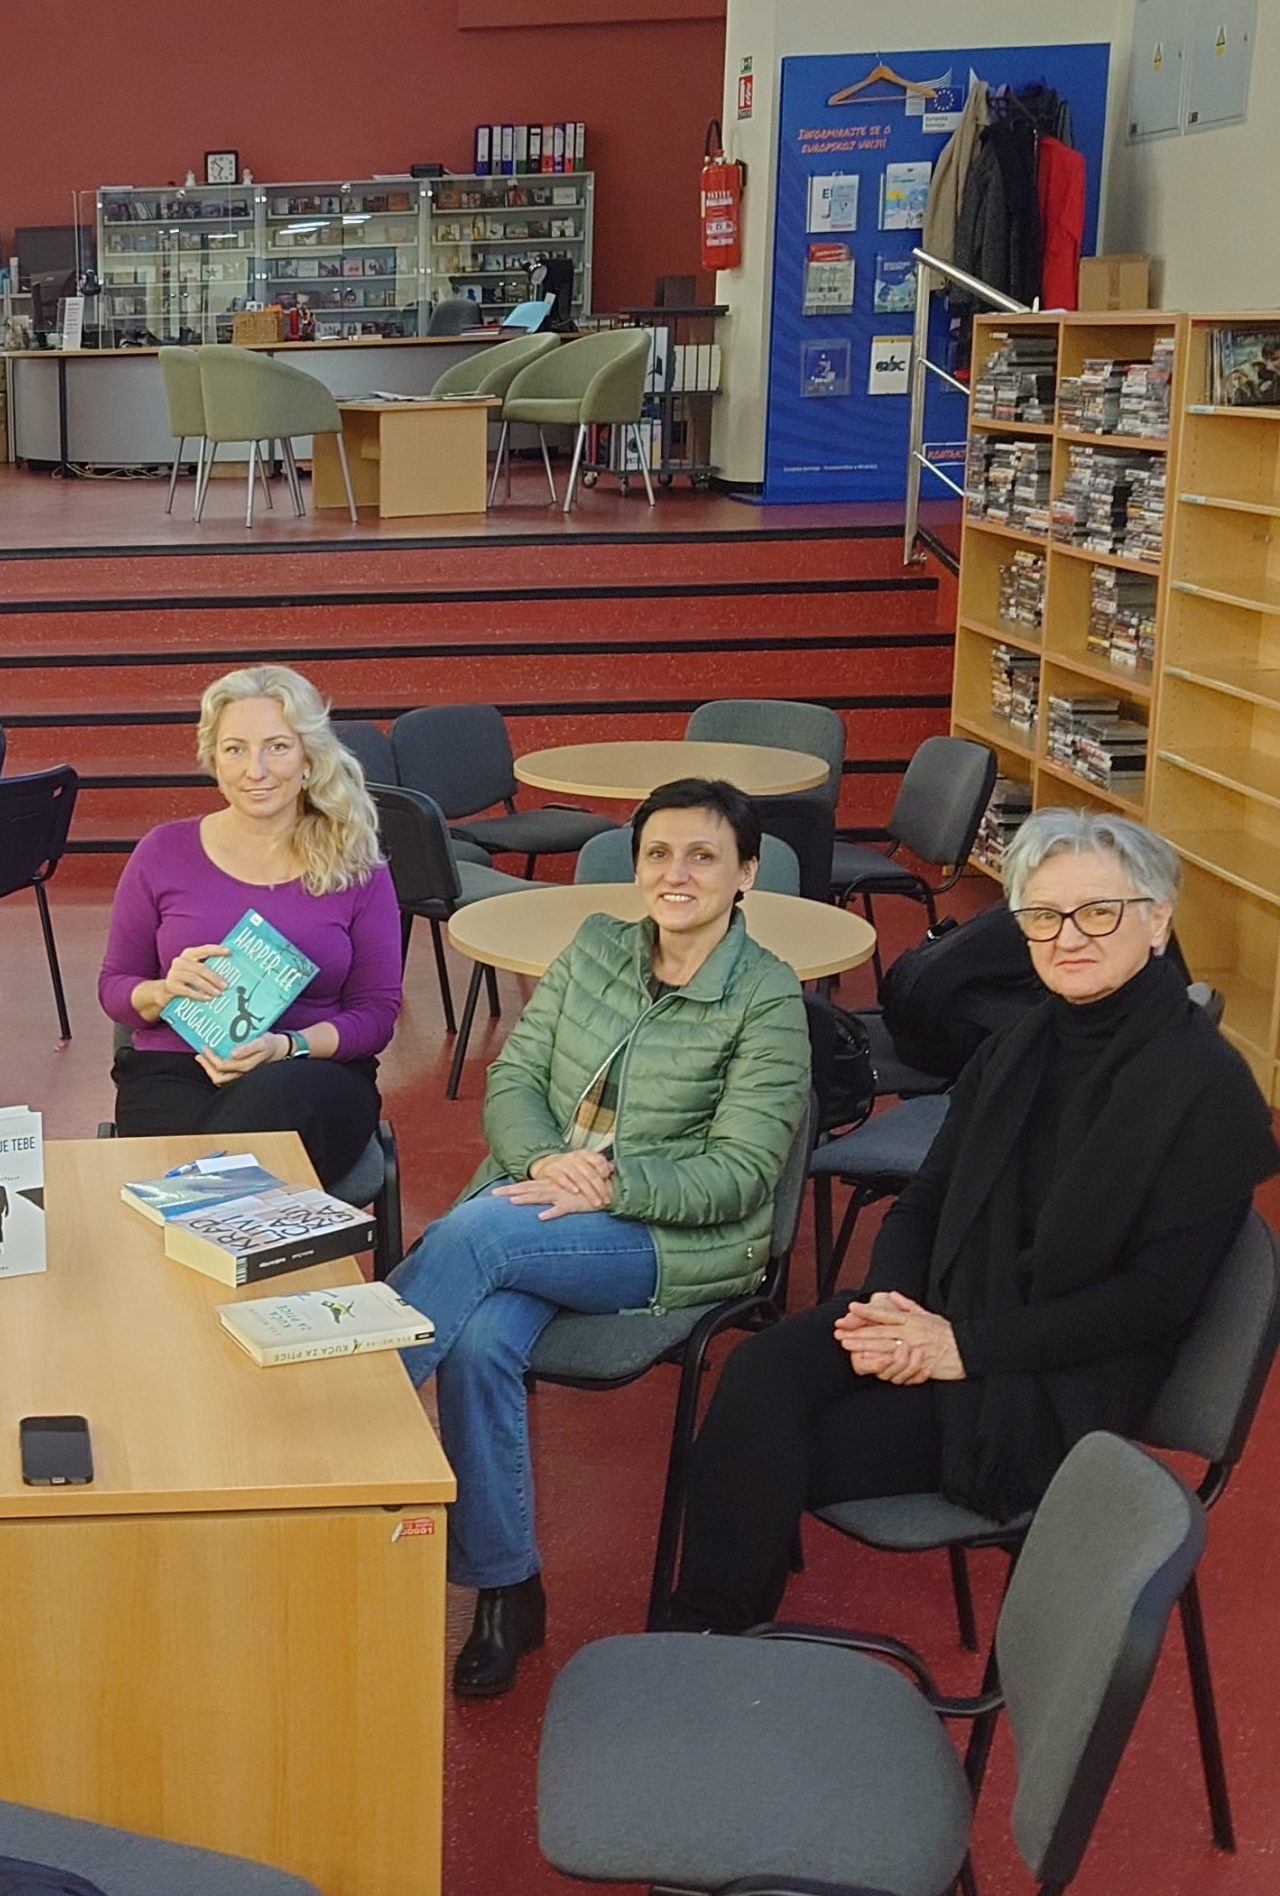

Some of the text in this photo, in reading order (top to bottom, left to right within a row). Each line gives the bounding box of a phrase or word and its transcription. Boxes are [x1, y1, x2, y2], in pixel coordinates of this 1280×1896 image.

[234, 926, 302, 992] HARPER LEE
[174, 998, 228, 1048] RUGALICU
[12, 1136, 36, 1151] TEBE
[320, 1204, 354, 1224] GA
[190, 1220, 260, 1251] KRAD
[270, 1217, 310, 1236] CA
[274, 1344, 348, 1362] KUĆA ZA PTICE
